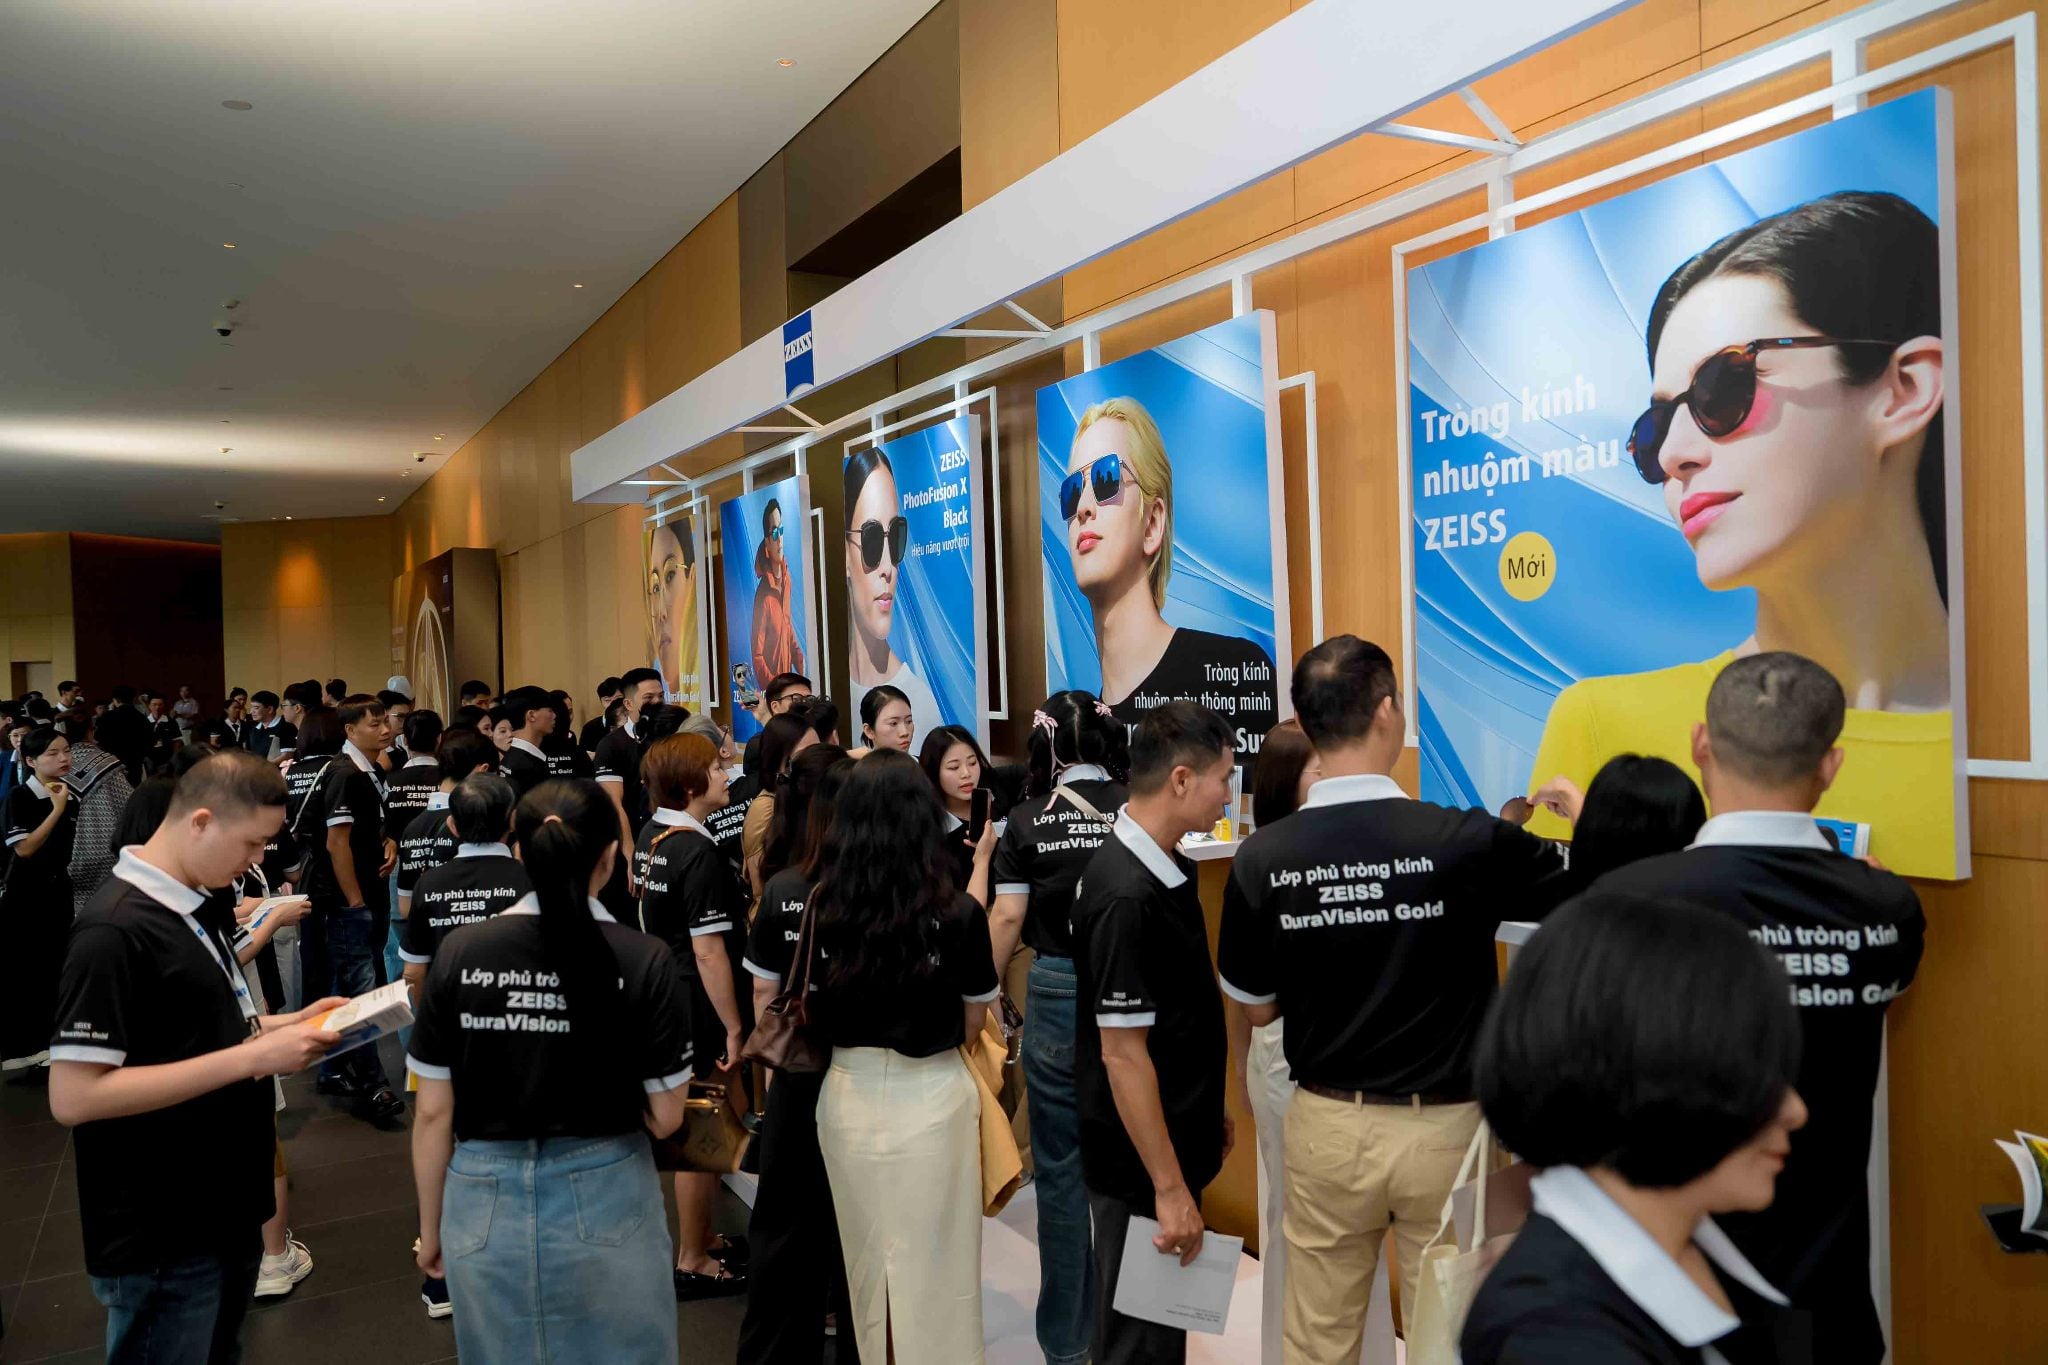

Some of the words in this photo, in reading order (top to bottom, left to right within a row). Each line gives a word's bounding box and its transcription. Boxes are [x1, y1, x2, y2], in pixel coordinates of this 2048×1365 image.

[784, 331, 812, 362] ZEISS
[1421, 401, 1510, 443] Tròng
[1521, 374, 1597, 423] kính
[940, 449, 967, 472] ZEISS
[1423, 451, 1530, 497] nhuộm
[1542, 434, 1619, 478] màu
[903, 482, 958, 511] PhotoFusion
[960, 477, 967, 496] X
[943, 505, 968, 529] Black
[1424, 508, 1507, 551] ZEISS
[1508, 553, 1546, 580] Mới
[1204, 662, 1239, 687] Tròng
[1243, 661, 1270, 681] kính
[1200, 691, 1236, 716] thông
[1240, 691, 1272, 711] minh
[707, 807, 723, 823] phủ
[724, 802, 746, 816] tròng
[715, 813, 744, 830] ZEISS
[1033, 814, 1055, 826] Lớp
[1058, 810, 1080, 822] phủ
[713, 826, 743, 842] aVisio
[1067, 823, 1111, 834] ZEISS
[1036, 837, 1104, 853] DuraVisi
[1270, 871, 1301, 887] Lớp
[1306, 863, 1339, 885] phủ
[1343, 862, 1390, 879] tròng
[1394, 857, 1434, 874] kính
[424, 892, 442, 902] Lớp
[444, 889, 464, 900] phủ
[466, 888, 491, 899] tròng
[493, 887, 516, 897] kính
[650, 880, 667, 892] Gold
[1318, 883, 1384, 904] ZEISS
[450, 901, 486, 912] ZEISS
[782, 901, 804, 912] Lớp
[1280, 907, 1389, 930] DuraVision
[1394, 901, 1444, 920] Gold
[1795, 924, 1861, 950] tròng
[1778, 953, 1850, 976] EISS
[461, 968, 494, 988] Lớp
[498, 969, 531, 988] phủ
[535, 971, 560, 988] trò
[506, 991, 567, 1011] ZEISS
[1789, 984, 1854, 1006] ision
[460, 1013, 570, 1033] DuraVision
